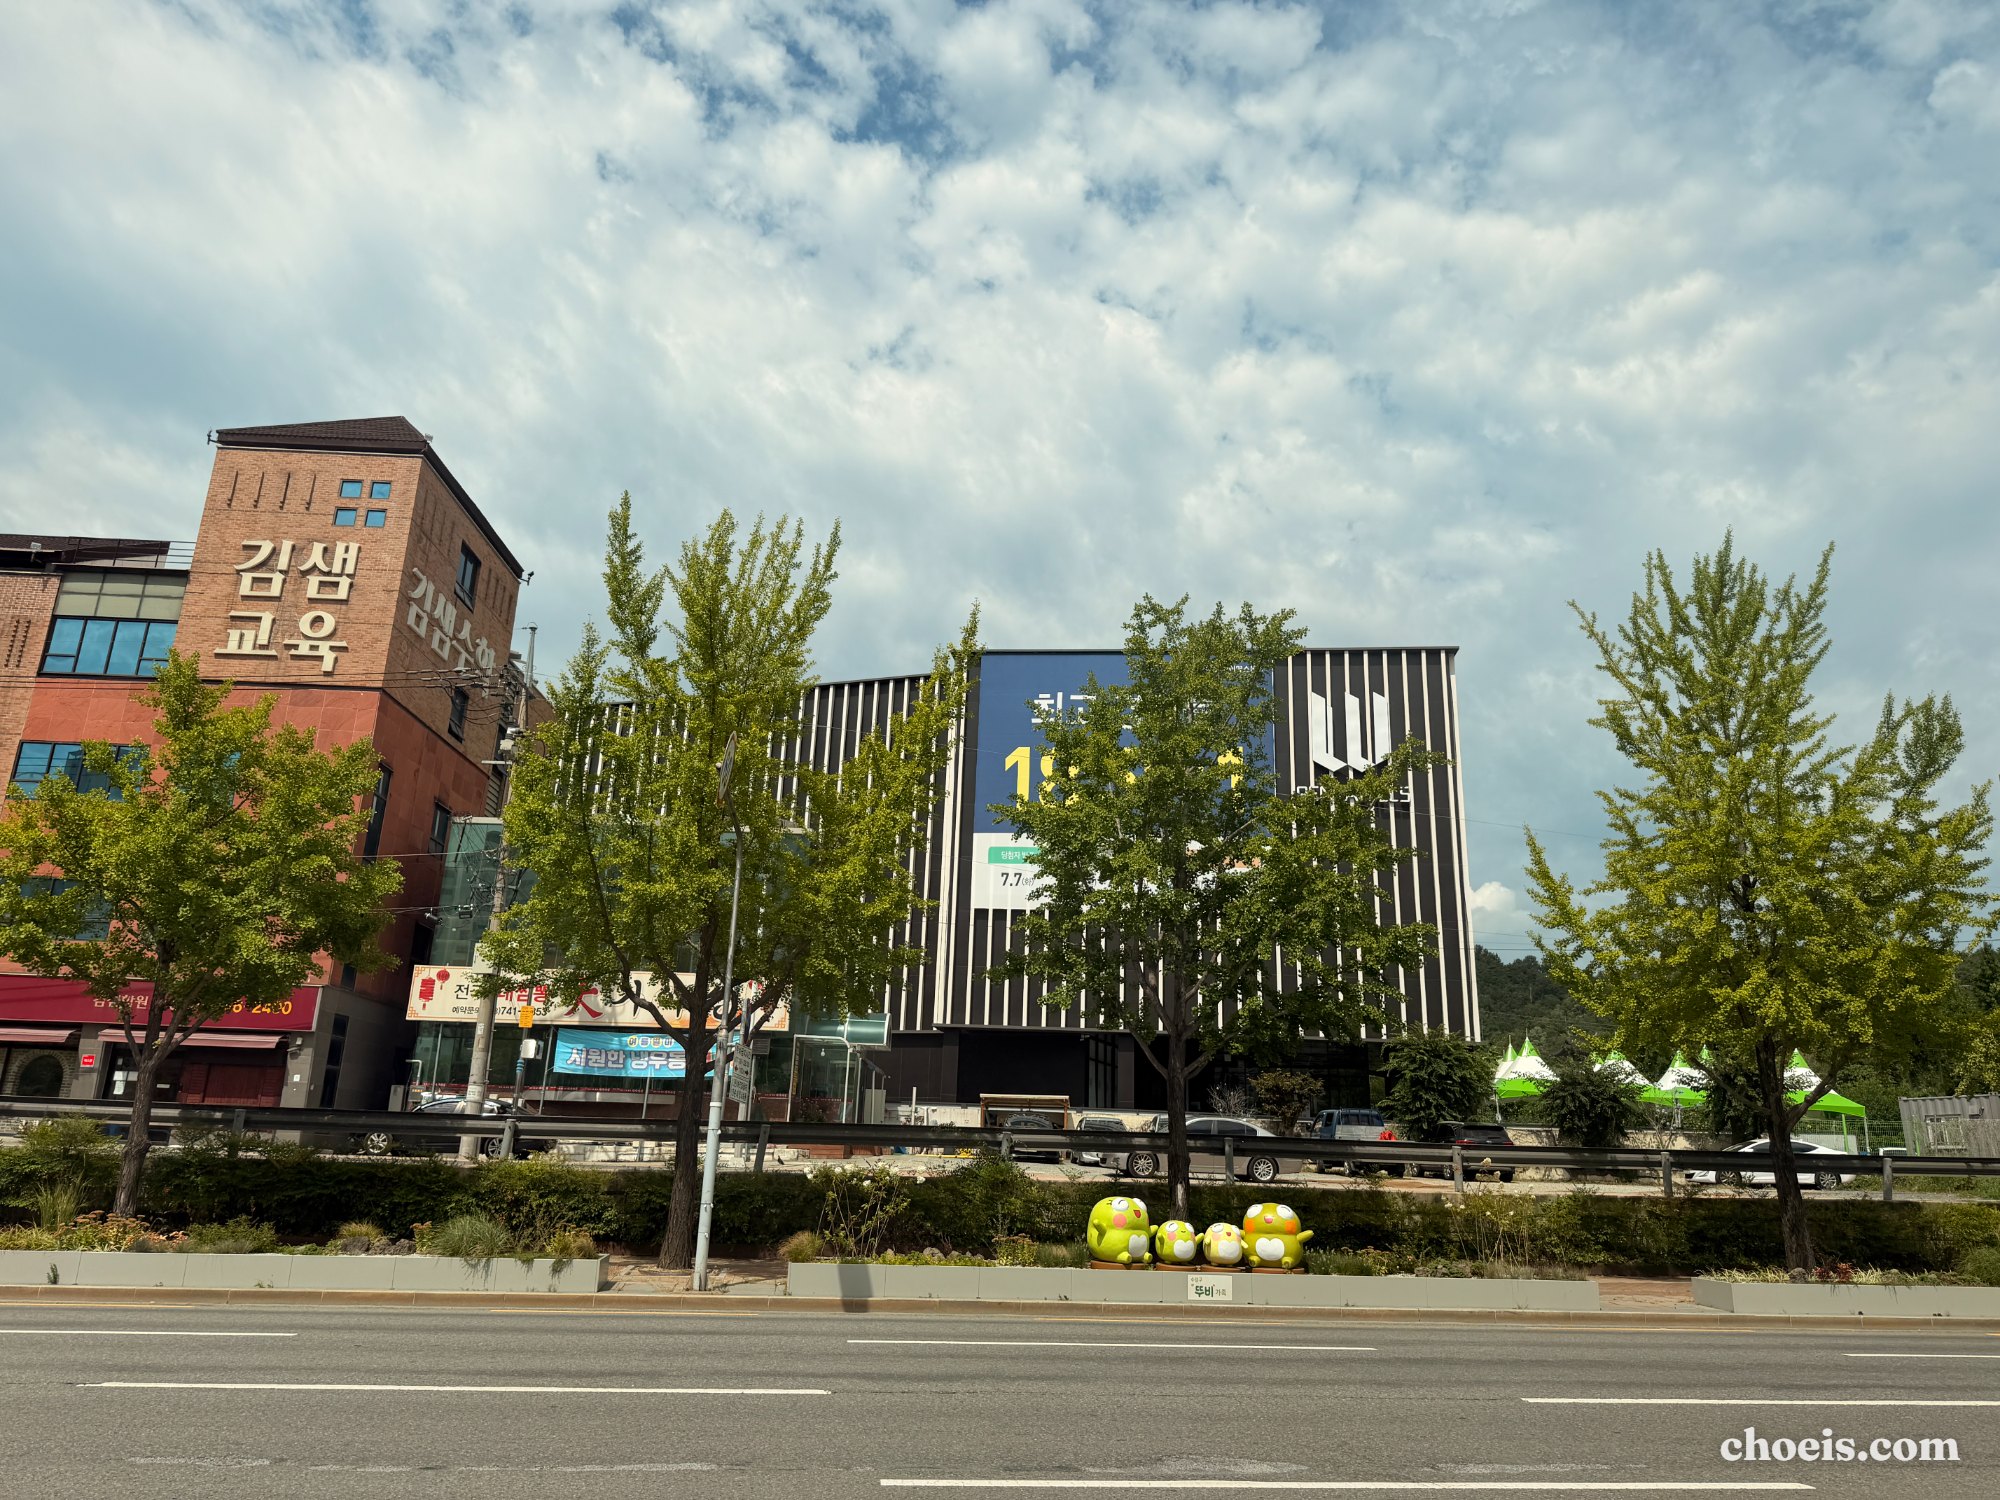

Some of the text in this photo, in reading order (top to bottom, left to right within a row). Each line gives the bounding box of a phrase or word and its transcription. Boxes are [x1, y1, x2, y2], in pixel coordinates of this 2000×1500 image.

[233, 539, 361, 601] 김샘
[213, 610, 349, 673] 교육
[407, 567, 496, 701] 김샘수학
[566, 1047, 626, 1069] 시원한
[631, 1049, 686, 1070] 냉우동
[1194, 1285, 1227, 1298] 뚜비 가족
